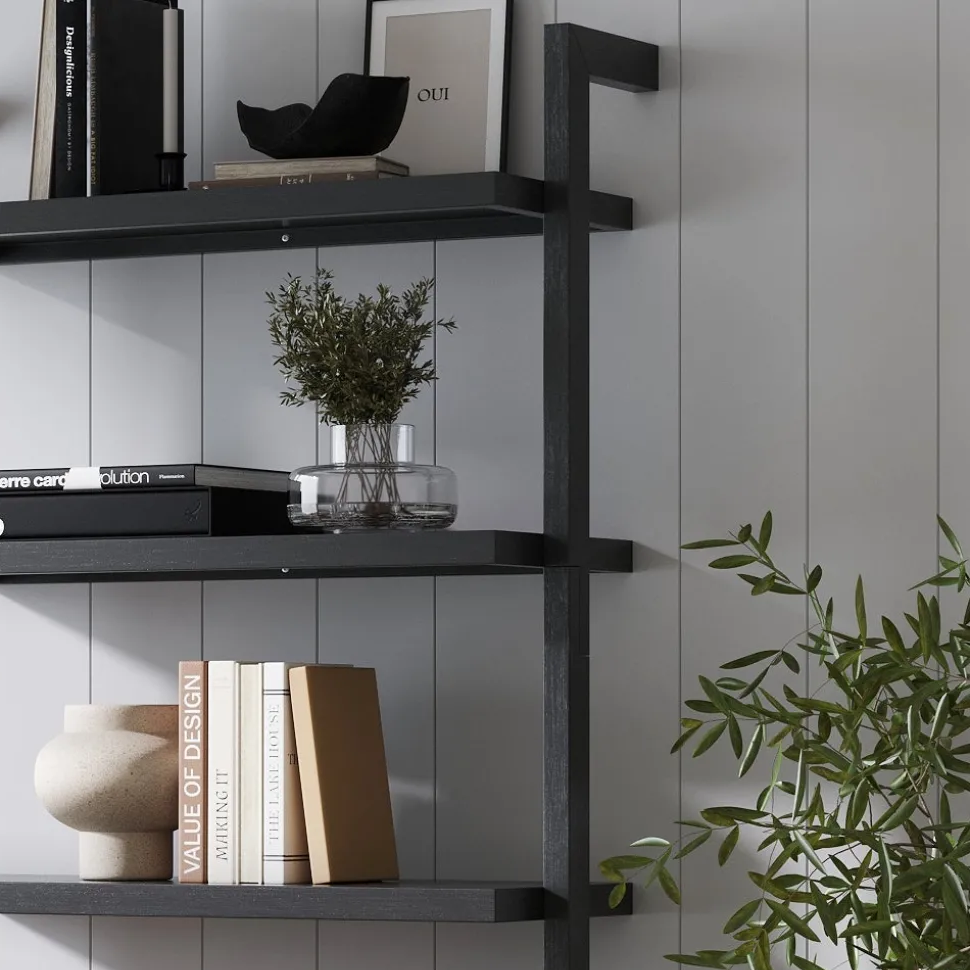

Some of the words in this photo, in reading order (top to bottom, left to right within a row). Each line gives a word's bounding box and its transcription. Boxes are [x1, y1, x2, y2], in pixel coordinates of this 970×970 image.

[64, 26, 75, 98] Designlicious
[417, 87, 449, 102] OUI
[33, 472, 67, 488] card
[184, 675, 201, 760] DESIGN
[269, 704, 279, 758] HOUSE
[184, 767, 201, 797] OF
[216, 768, 228, 785] IT
[269, 764, 279, 804] LAKE
[184, 804, 201, 874] VALUE
[216, 791, 228, 861] MAKING
[269, 810, 279, 844] THE
